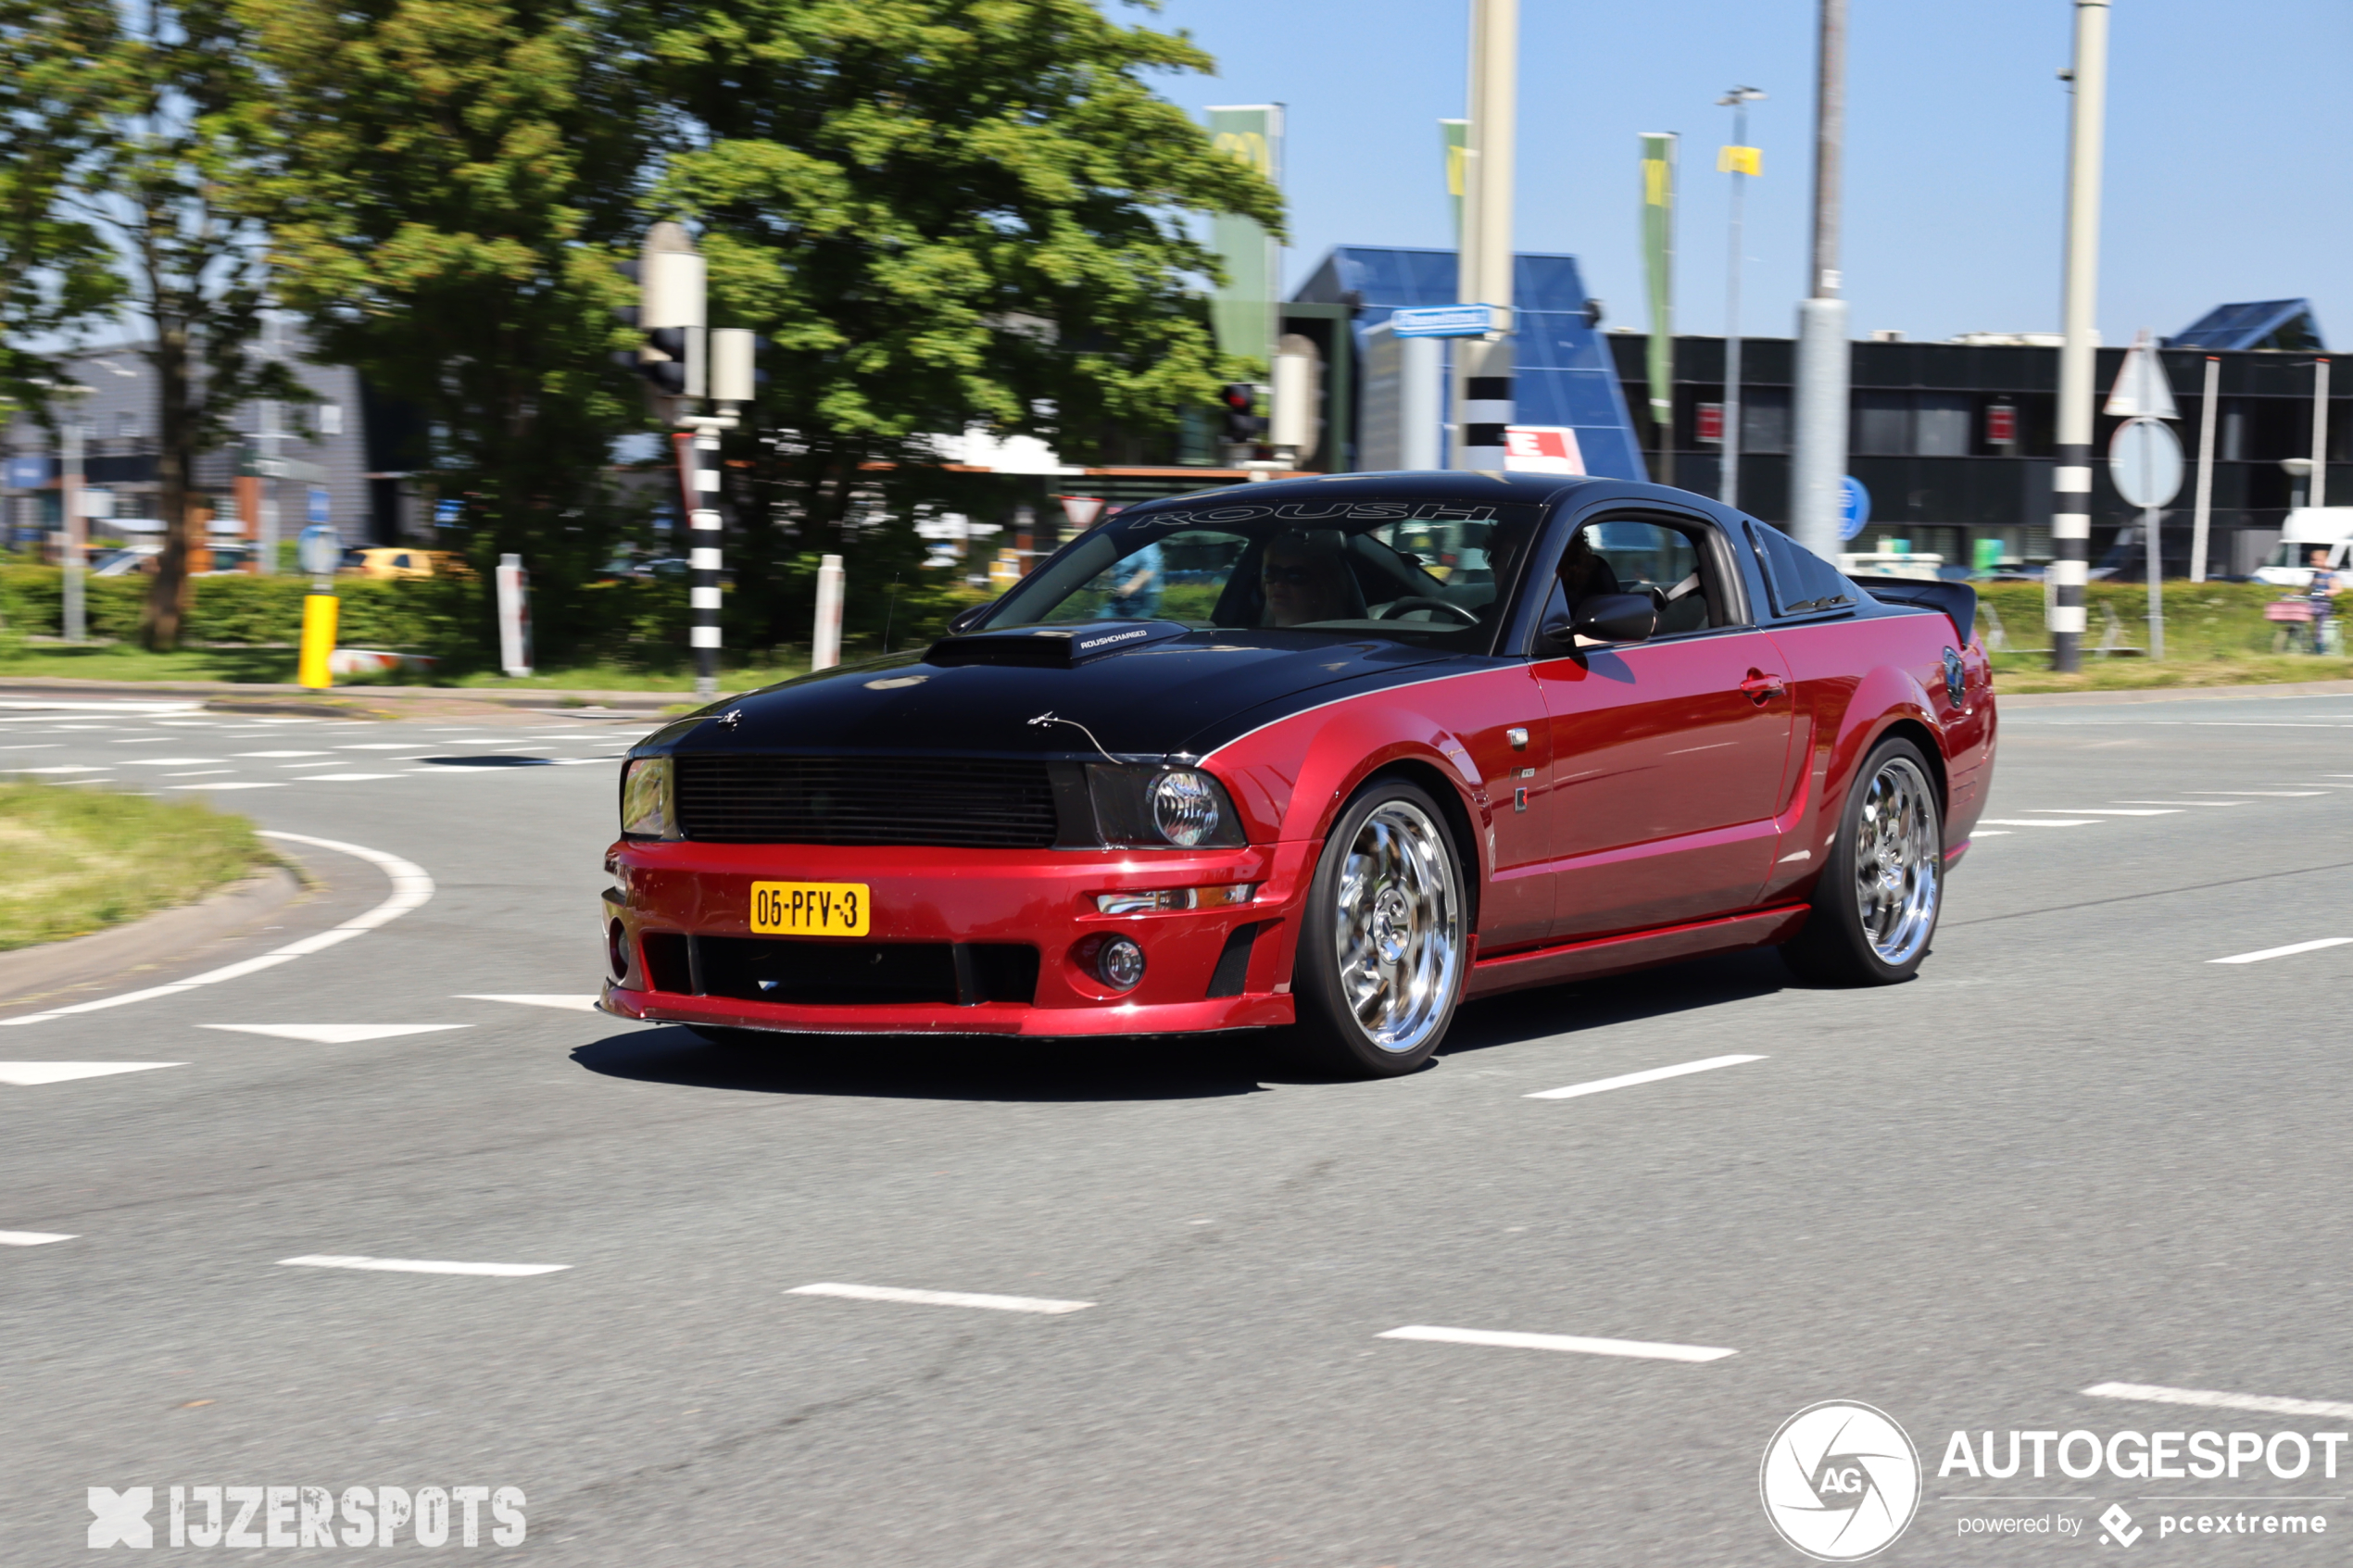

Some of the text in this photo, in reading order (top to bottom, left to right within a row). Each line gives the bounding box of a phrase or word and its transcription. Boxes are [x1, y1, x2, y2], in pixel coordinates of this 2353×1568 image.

[1128, 502, 1497, 530] ROUSH
[1079, 629, 1148, 650] ROUSHCHARGED
[757, 889, 858, 928] 05-PFV-3
